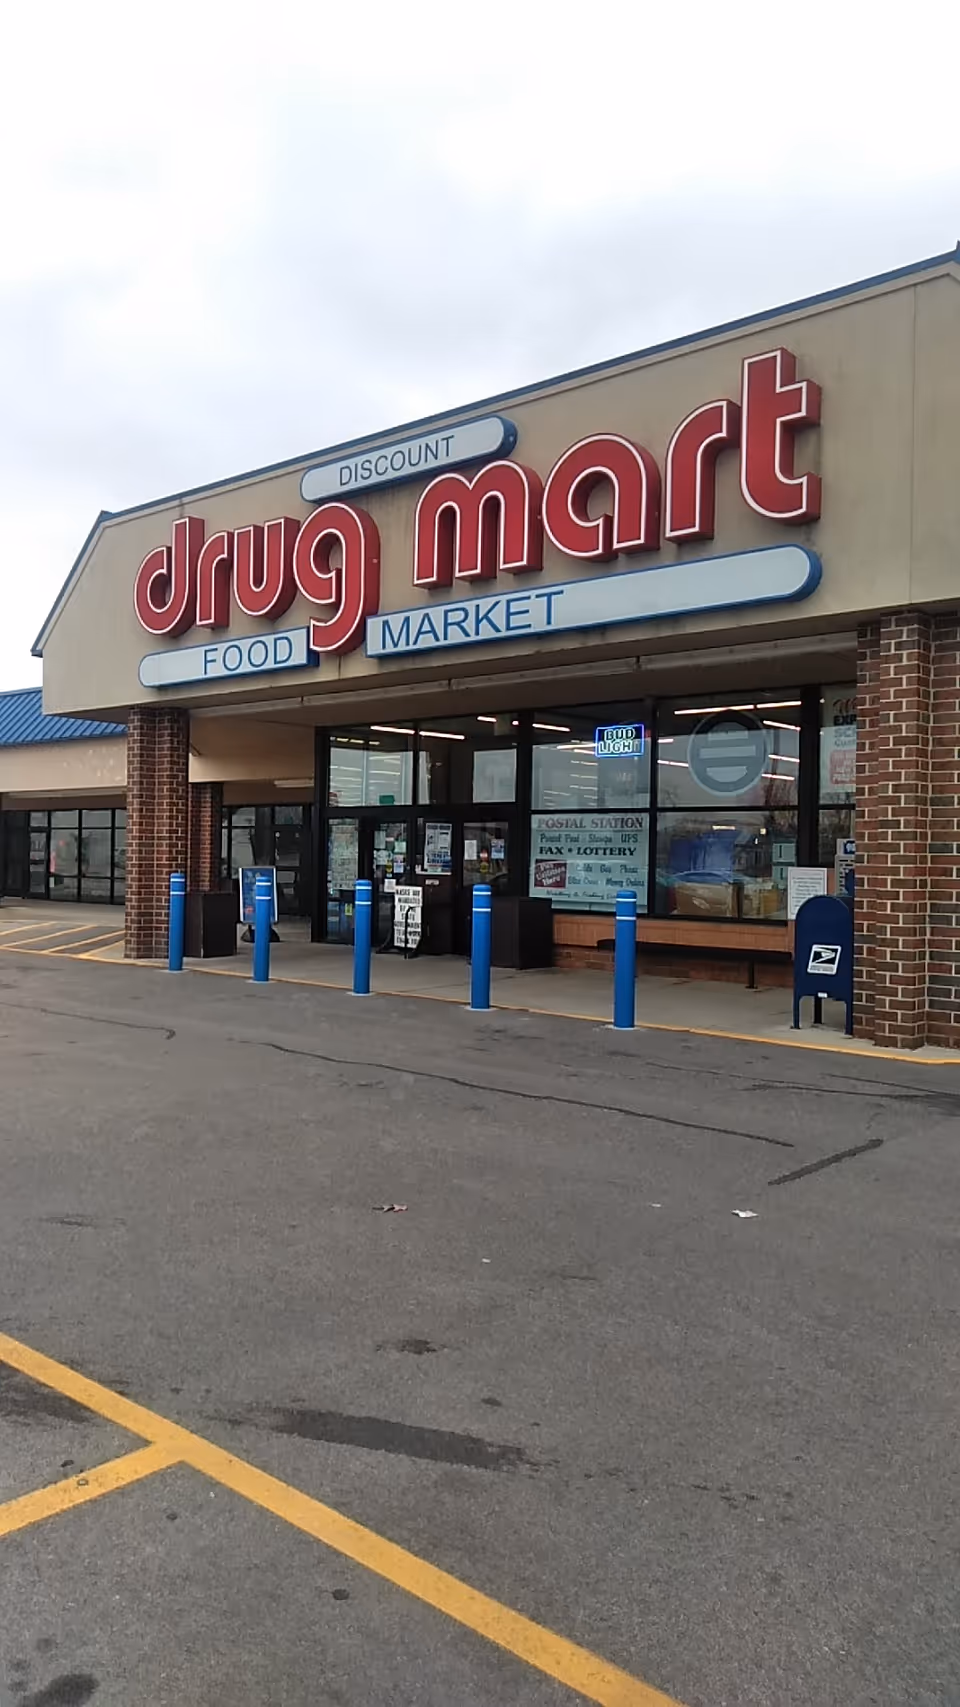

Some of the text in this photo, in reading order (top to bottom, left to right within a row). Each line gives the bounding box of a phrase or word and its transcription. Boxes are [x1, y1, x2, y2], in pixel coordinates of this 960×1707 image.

[339, 435, 455, 487] DISCOUNT
[134, 348, 818, 654] drug mart
[203, 589, 564, 676] FOOD MARKET
[604, 727, 636, 741] BUD
[598, 739, 641, 754] LIGHT
[537, 816, 644, 829] POSTAL STATION
[539, 846, 637, 857] FAX LOTTERY
